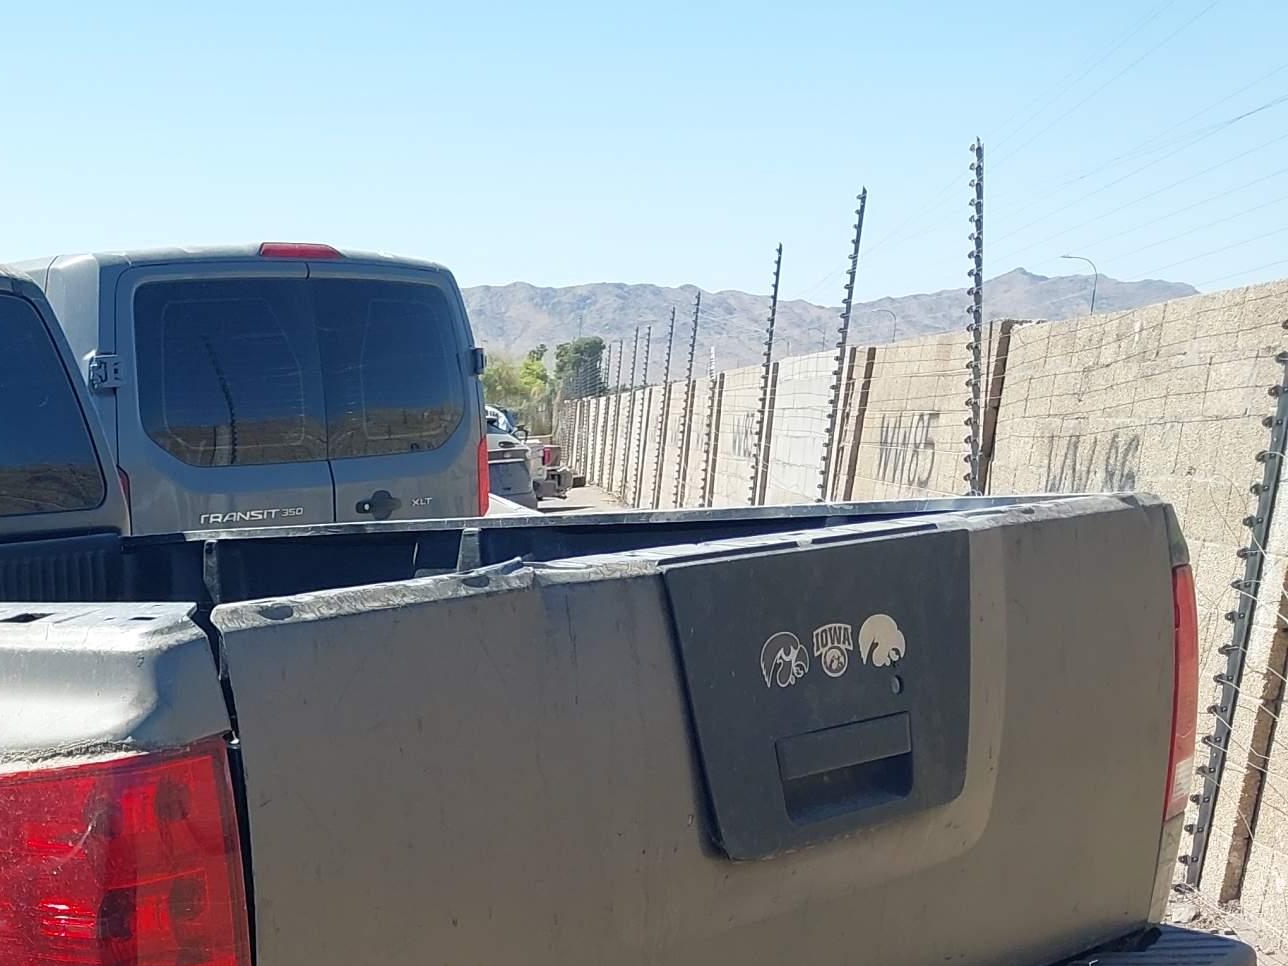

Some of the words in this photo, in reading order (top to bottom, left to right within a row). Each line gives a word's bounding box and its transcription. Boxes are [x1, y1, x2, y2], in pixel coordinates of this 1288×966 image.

[411, 497, 432, 506] XLT
[200, 508, 281, 525] TRANSIT
[281, 506, 303, 517] 350
[814, 624, 852, 652] IOWA
